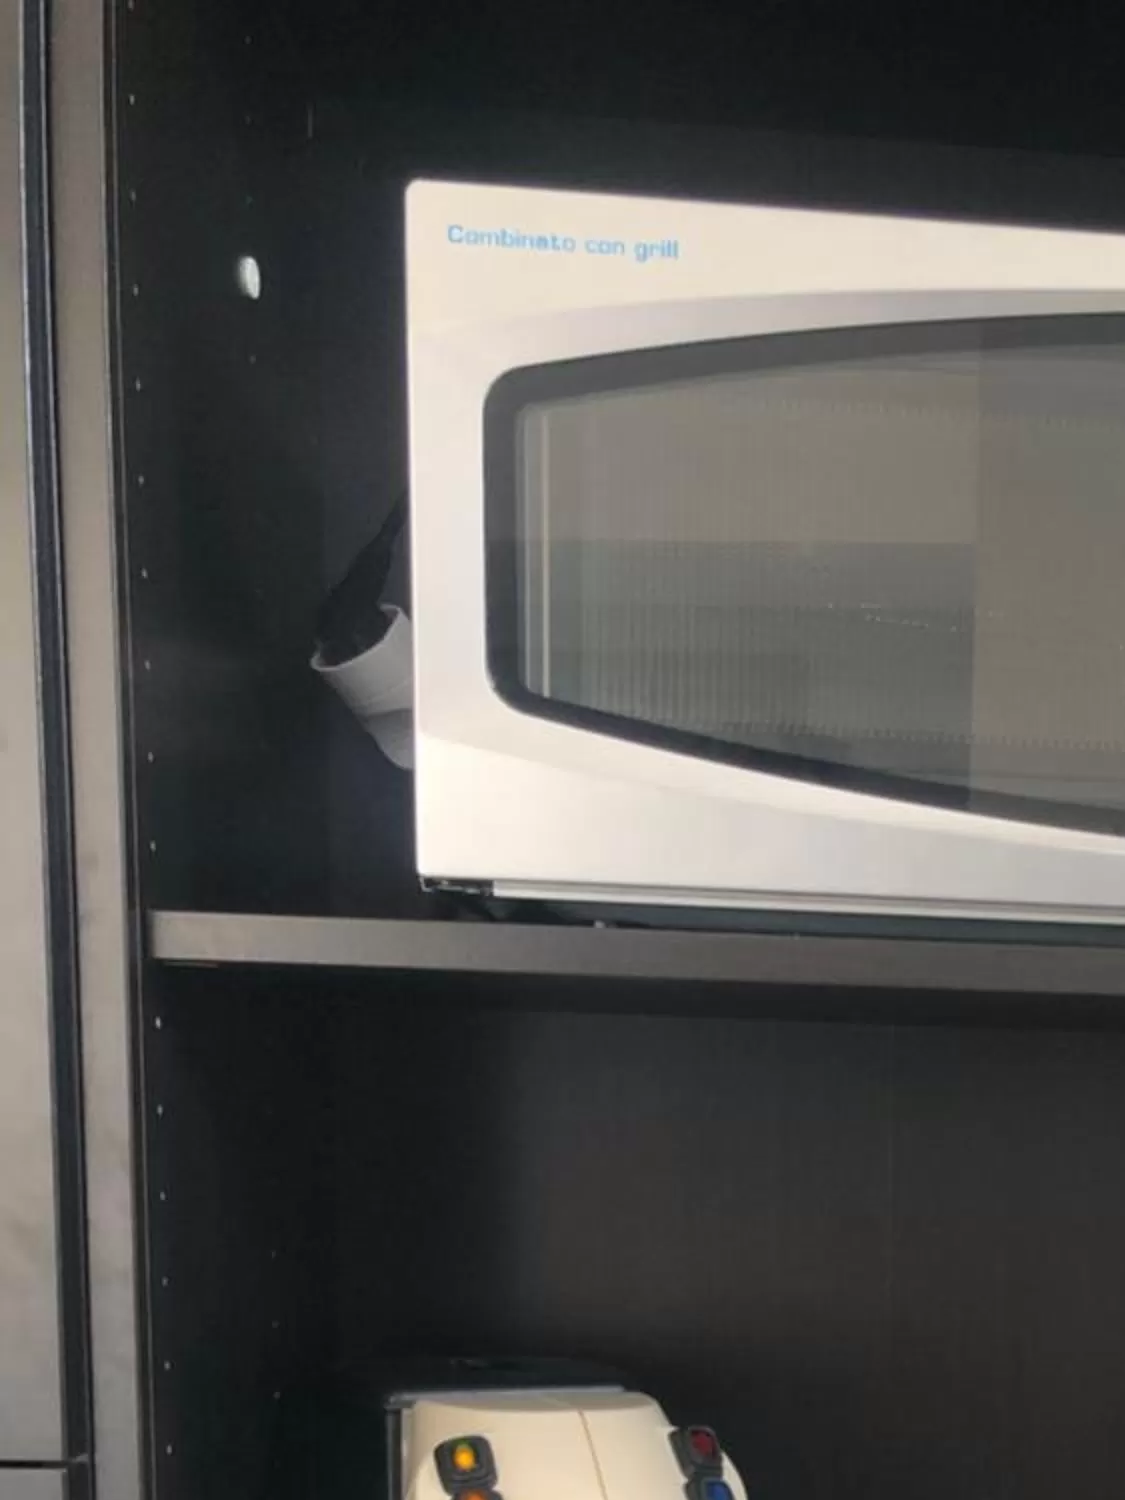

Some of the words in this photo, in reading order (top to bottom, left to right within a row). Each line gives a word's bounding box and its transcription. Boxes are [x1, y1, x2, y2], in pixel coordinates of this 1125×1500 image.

[447, 223, 576, 253] Combinato
[585, 239, 625, 256] con
[634, 239, 679, 263] grill
